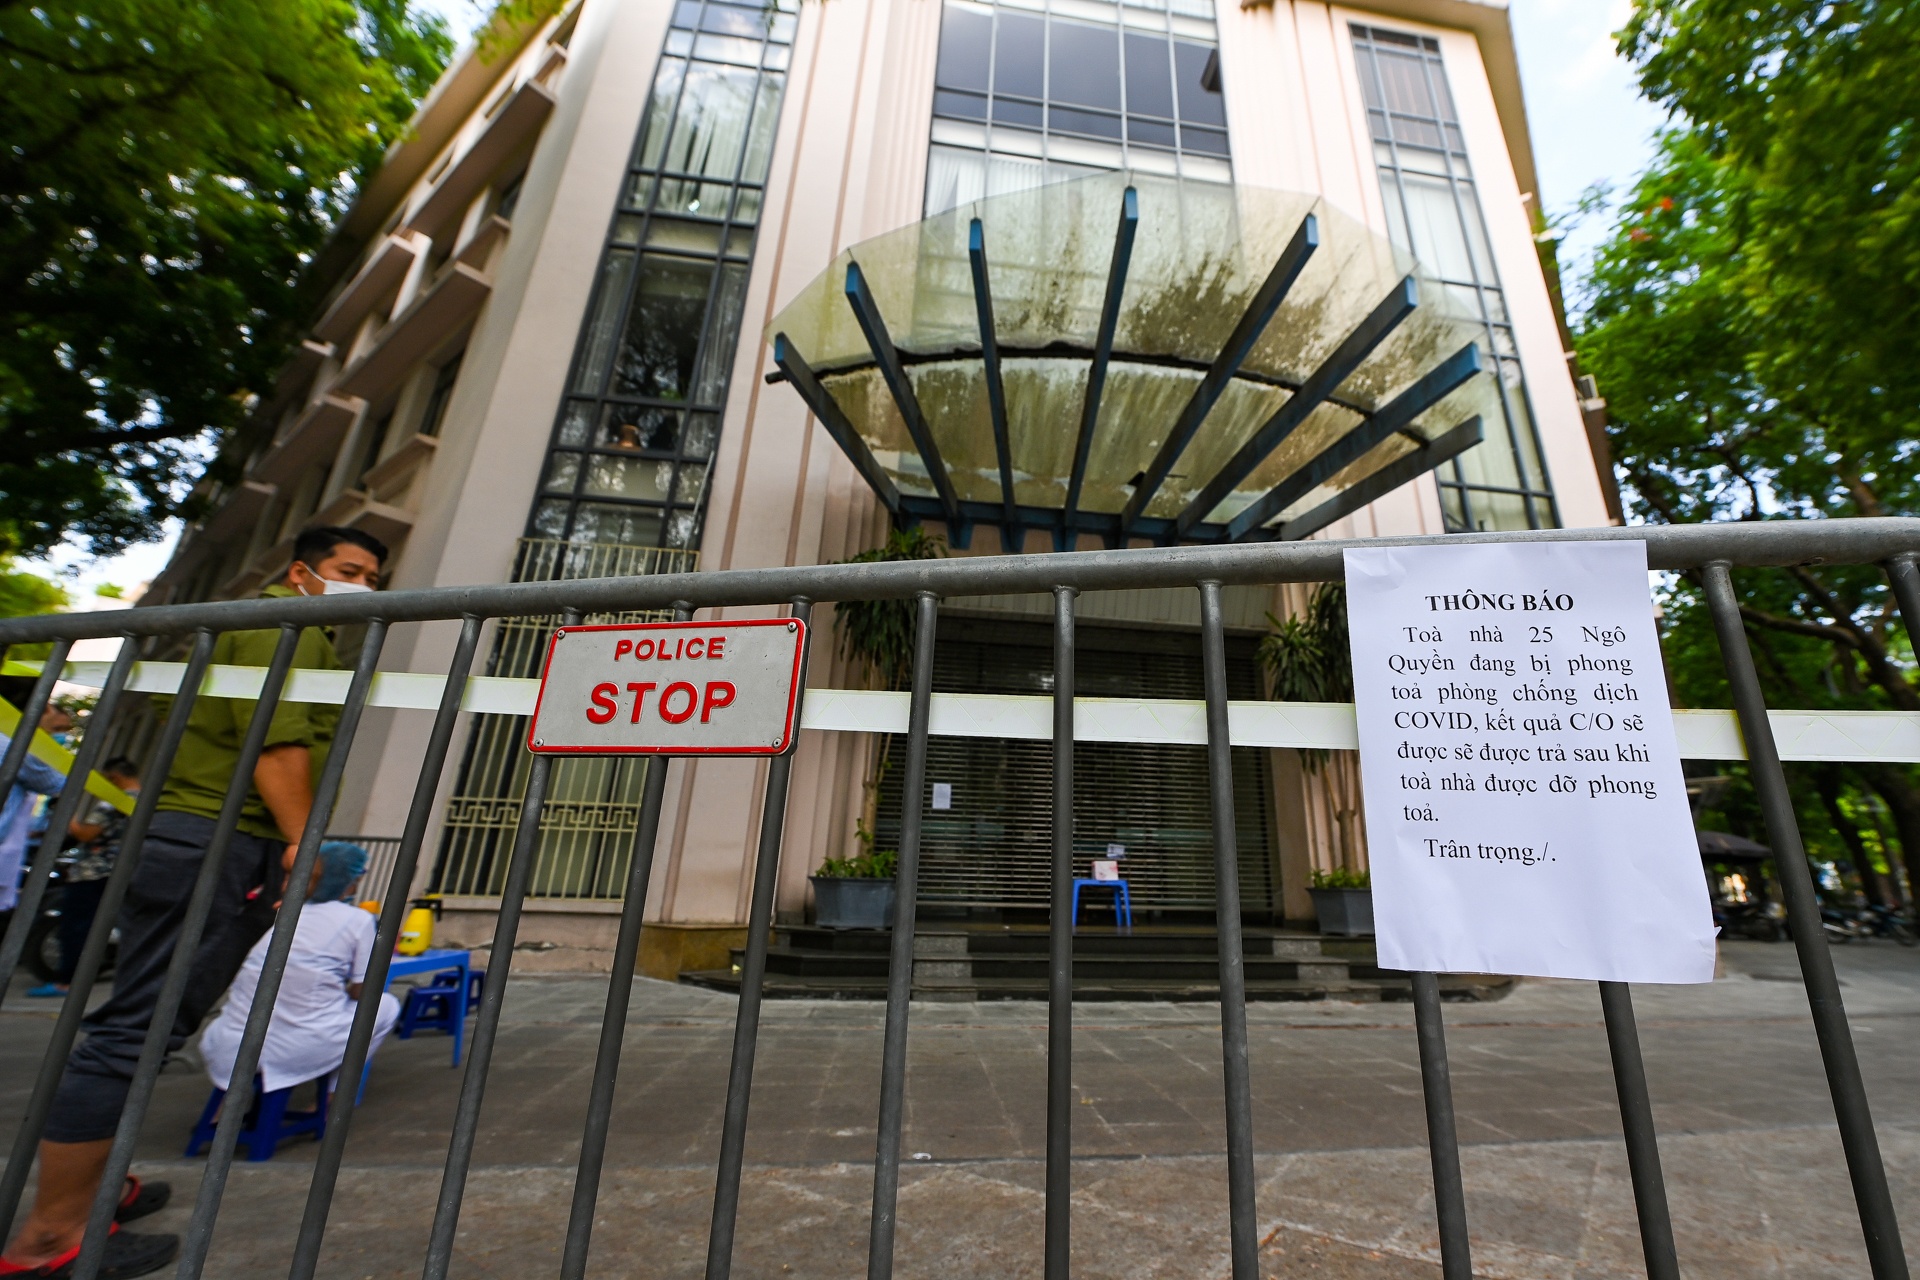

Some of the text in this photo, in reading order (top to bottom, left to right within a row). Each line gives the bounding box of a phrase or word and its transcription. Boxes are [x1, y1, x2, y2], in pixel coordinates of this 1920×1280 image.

[1425, 589, 1573, 611] THÔNG BÁO
[1403, 625, 1625, 646] Toà nhà 25 Ngô
[615, 637, 726, 660] POLICE
[1389, 649, 1633, 676] Quyền đang bị phong
[587, 681, 736, 724] STOP
[1392, 679, 1638, 705] toả phòng chống dịch
[1395, 708, 1643, 735] COVID, kết quả C/O sẽ
[1398, 741, 1650, 764] được sẽ được trả sau khi
[1401, 772, 1657, 799] toà nhà được dỡ phong
[1404, 803, 1438, 821] toả.
[1424, 839, 1471, 858] Trân
